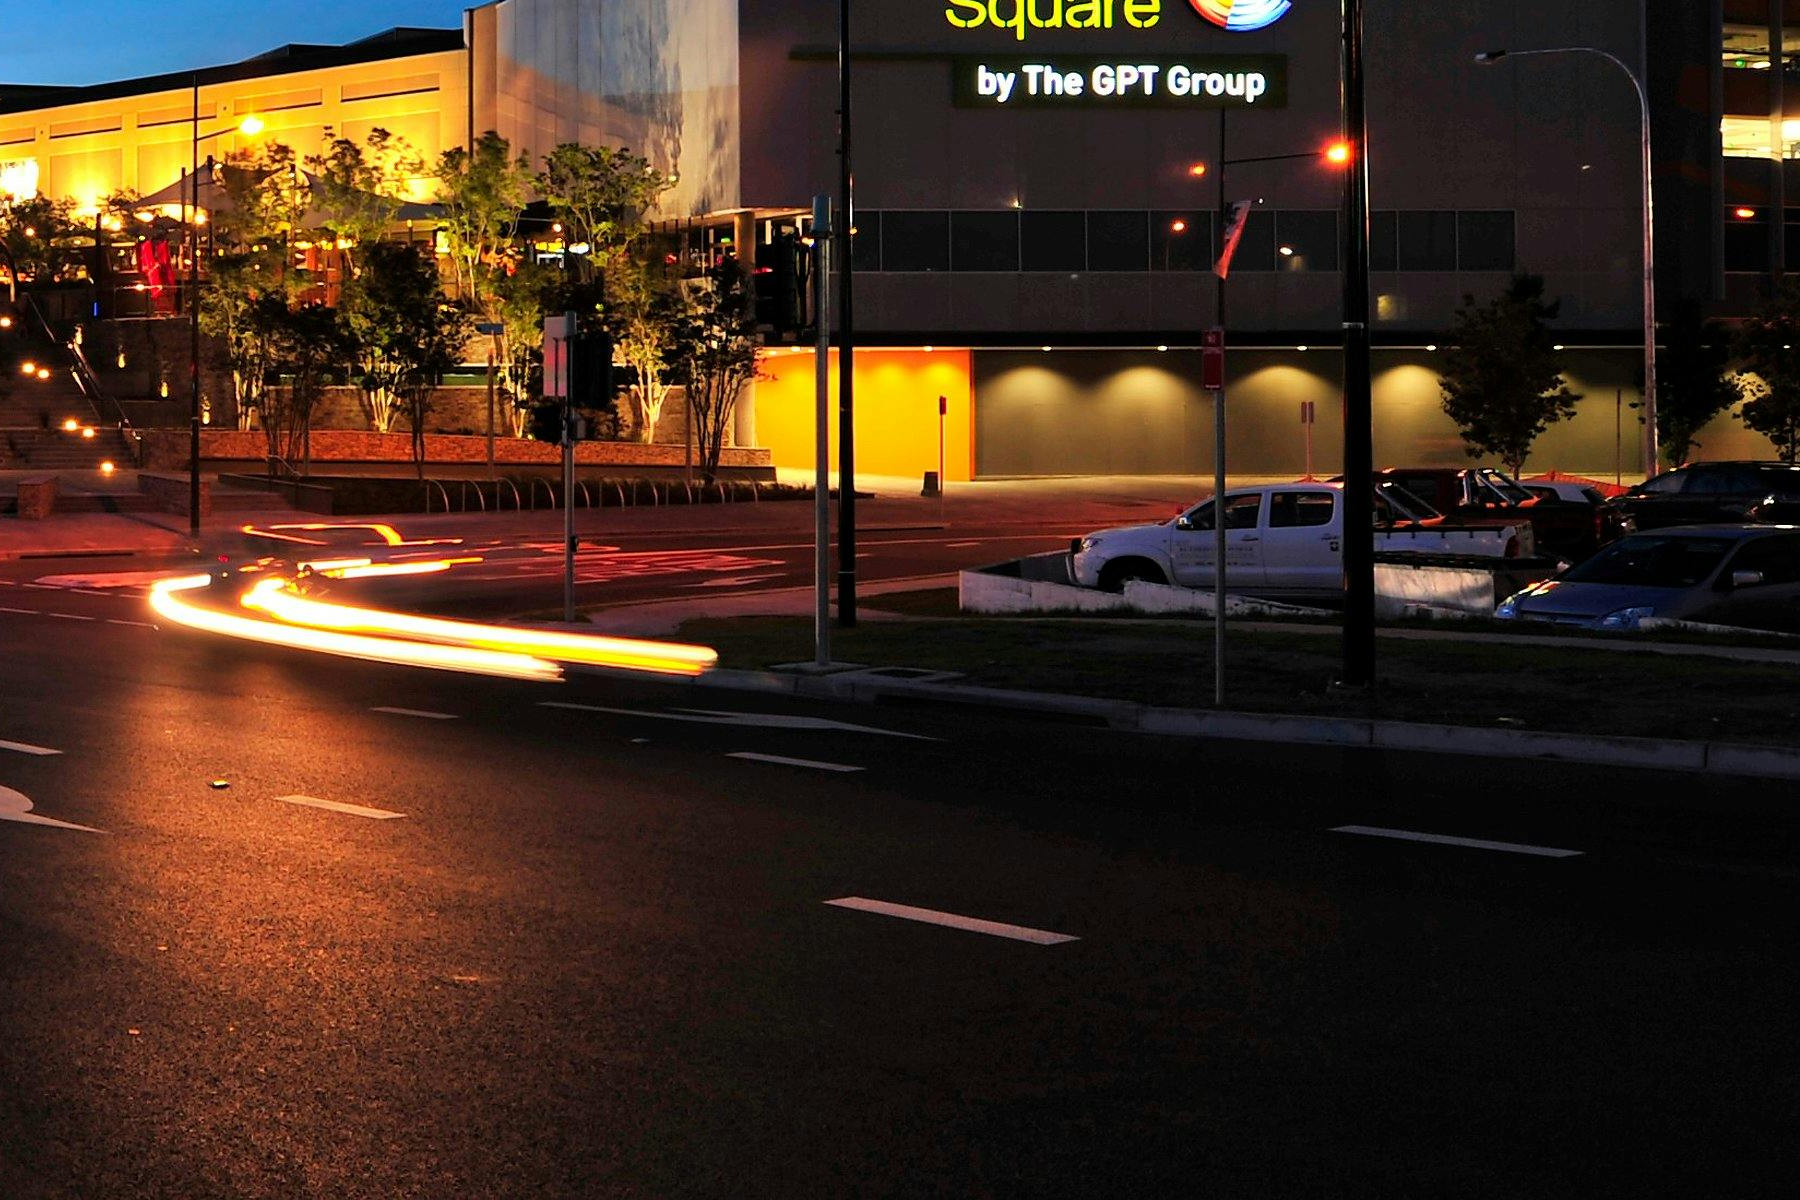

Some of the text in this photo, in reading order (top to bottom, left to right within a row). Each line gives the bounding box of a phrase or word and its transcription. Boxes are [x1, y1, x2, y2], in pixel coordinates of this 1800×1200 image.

[977, 64, 1266, 103] by The GPT Group
